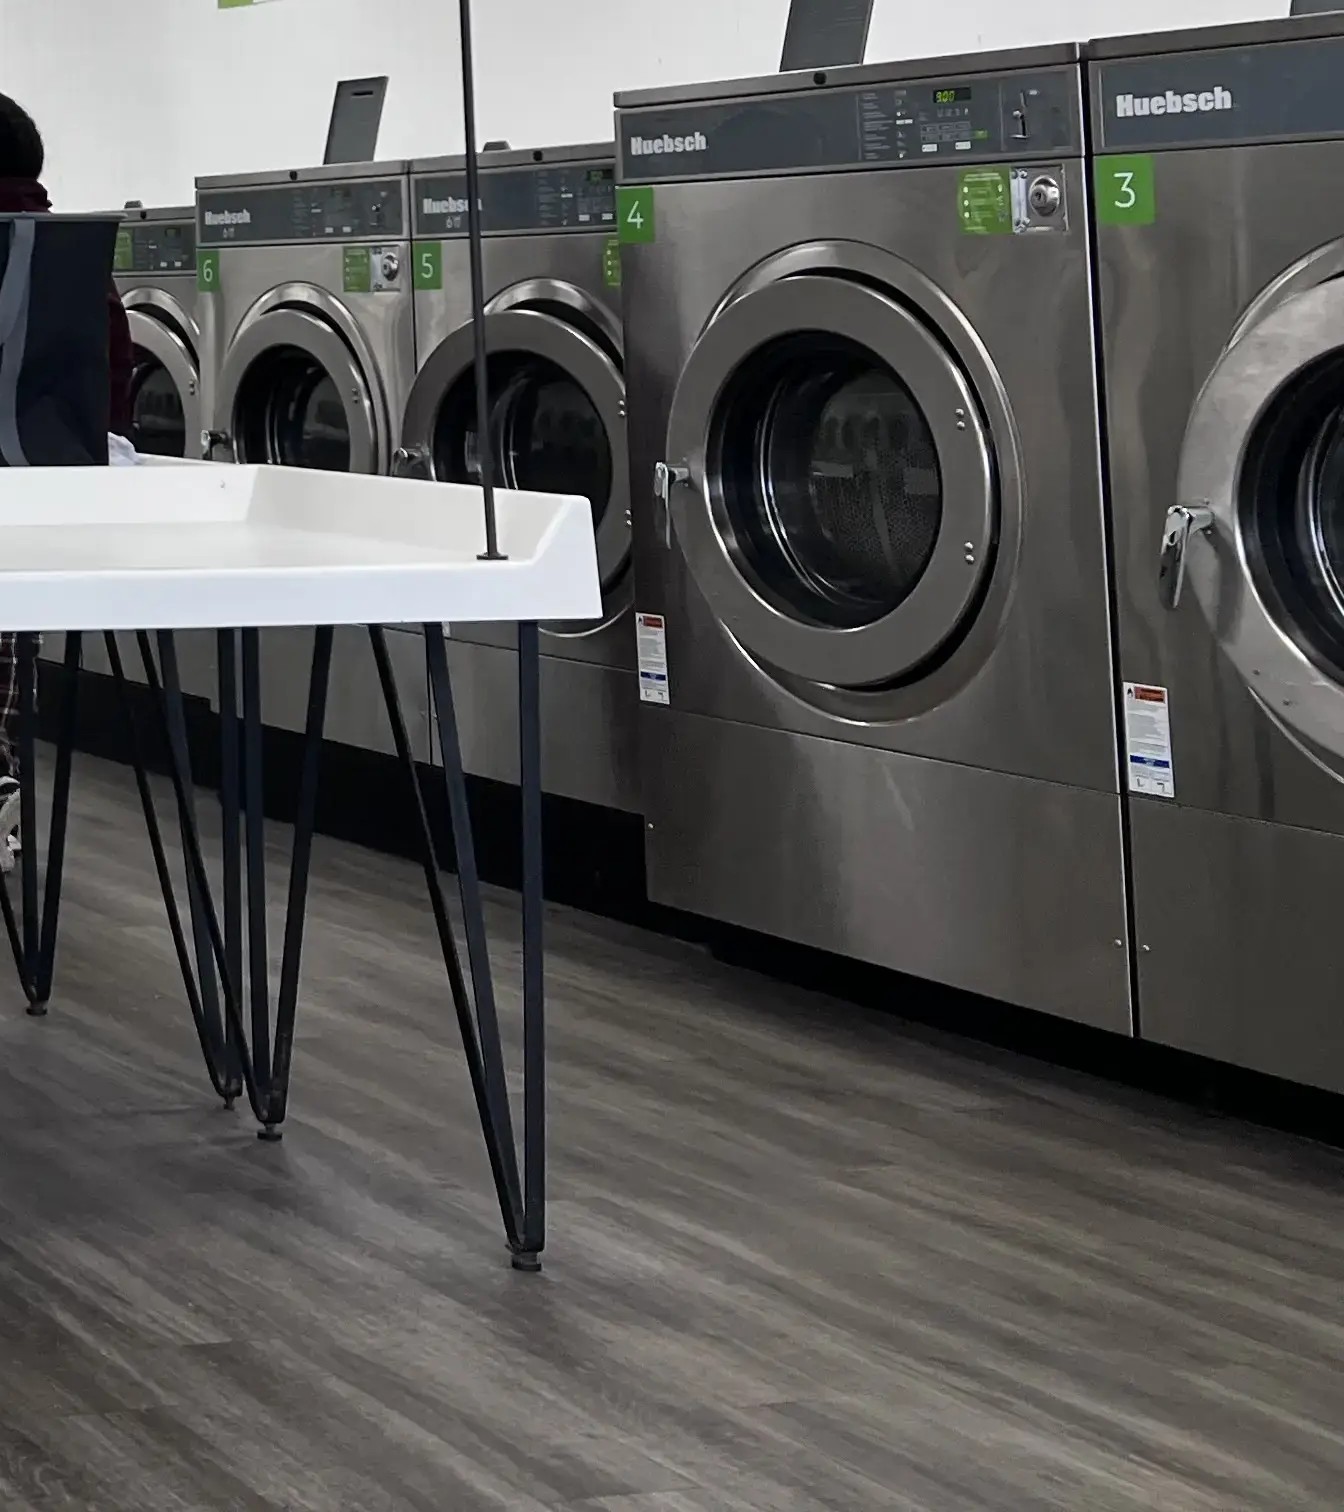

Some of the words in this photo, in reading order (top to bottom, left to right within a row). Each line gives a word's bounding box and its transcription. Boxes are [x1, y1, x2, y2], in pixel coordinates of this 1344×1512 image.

[1115, 86, 1232, 118] Huebsch
[629, 130, 707, 157] Huebsch
[1113, 172, 1136, 208] 3
[422, 196, 483, 215] Huebs
[626, 200, 644, 229] 4
[202, 259, 213, 283] 6
[421, 253, 433, 279] 5
